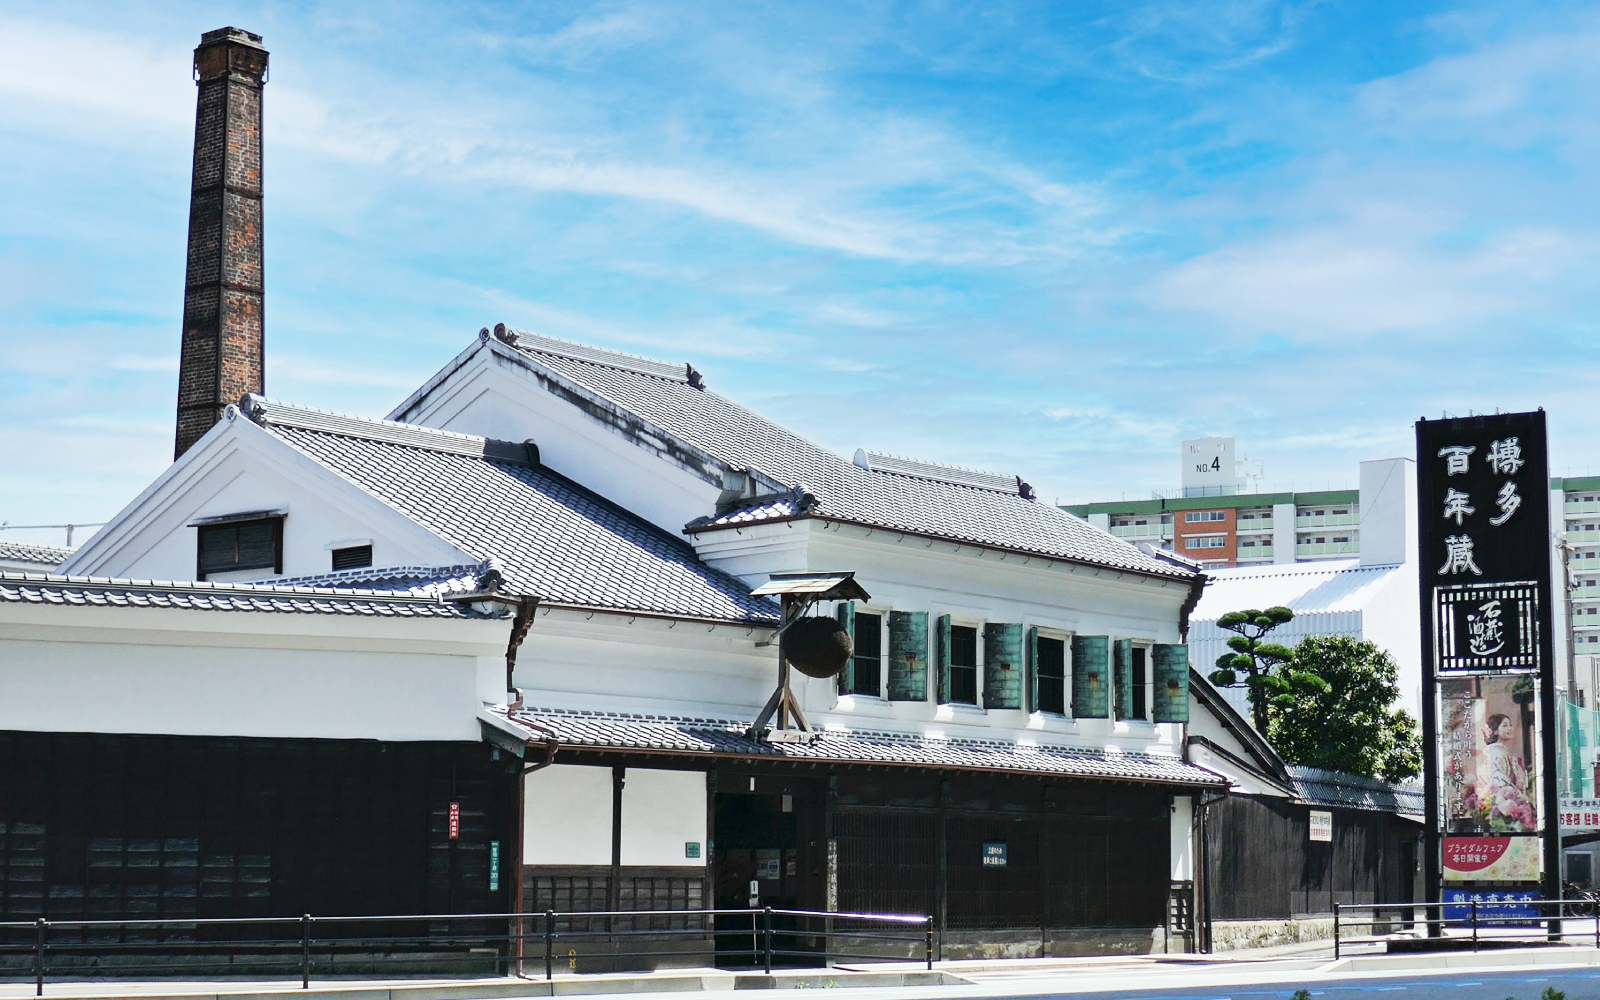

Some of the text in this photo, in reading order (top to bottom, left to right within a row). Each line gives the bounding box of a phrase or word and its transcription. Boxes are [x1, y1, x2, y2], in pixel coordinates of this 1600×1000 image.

[1486, 436, 1525, 527] 博多
[1437, 444, 1483, 576] 百年蔵
[1463, 690, 1473, 760] ここだから叶う
[1584, 812, 1600, 826] 駐輪
[1447, 844, 1503, 853] ブライダルフェア
[1452, 853, 1488, 863] 毎日開催中
